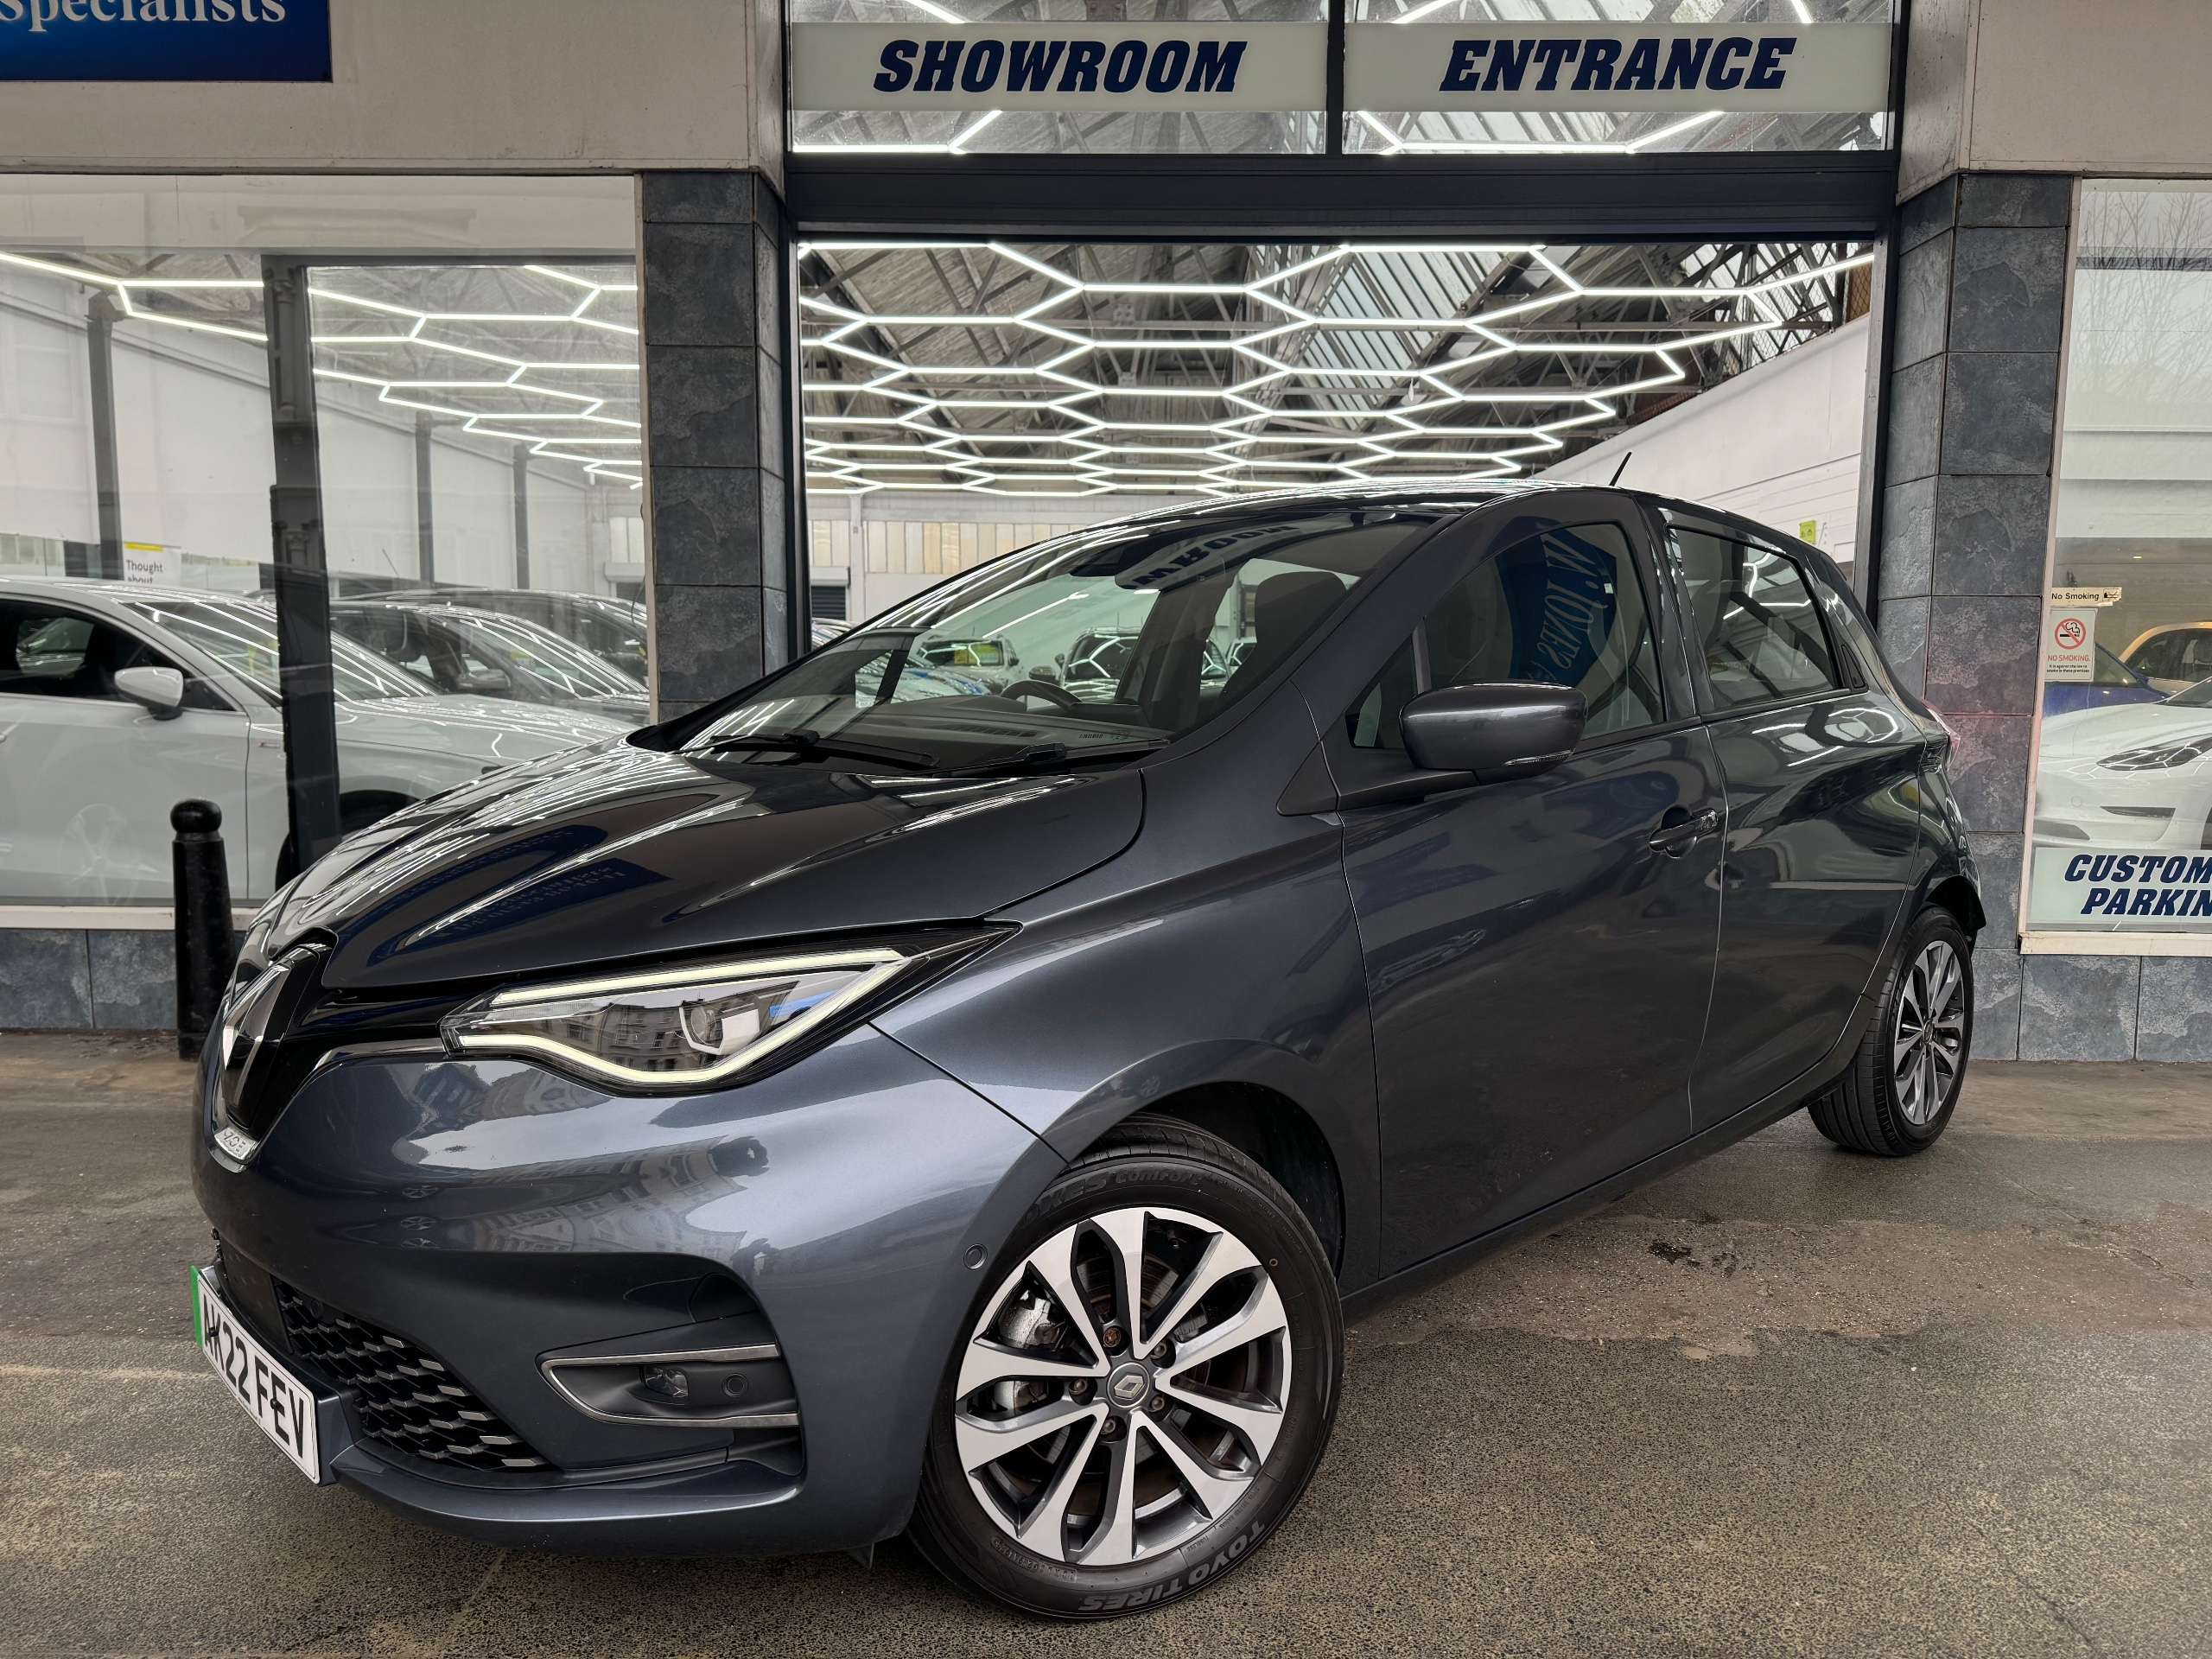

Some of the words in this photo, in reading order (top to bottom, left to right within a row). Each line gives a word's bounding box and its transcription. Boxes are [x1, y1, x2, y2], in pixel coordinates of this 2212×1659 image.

[873, 39, 1249, 93] SHOWROOM
[1439, 37, 1798, 92] ENTRANCE
[125, 559, 164, 575] Thought
[2065, 592, 2100, 601] Smoking
[203, 1294, 251, 1406] AK22
[254, 1354, 304, 1459] FEV
[1188, 1520, 1265, 1586] TOYO
[1078, 1582, 1183, 1611] TIRES
